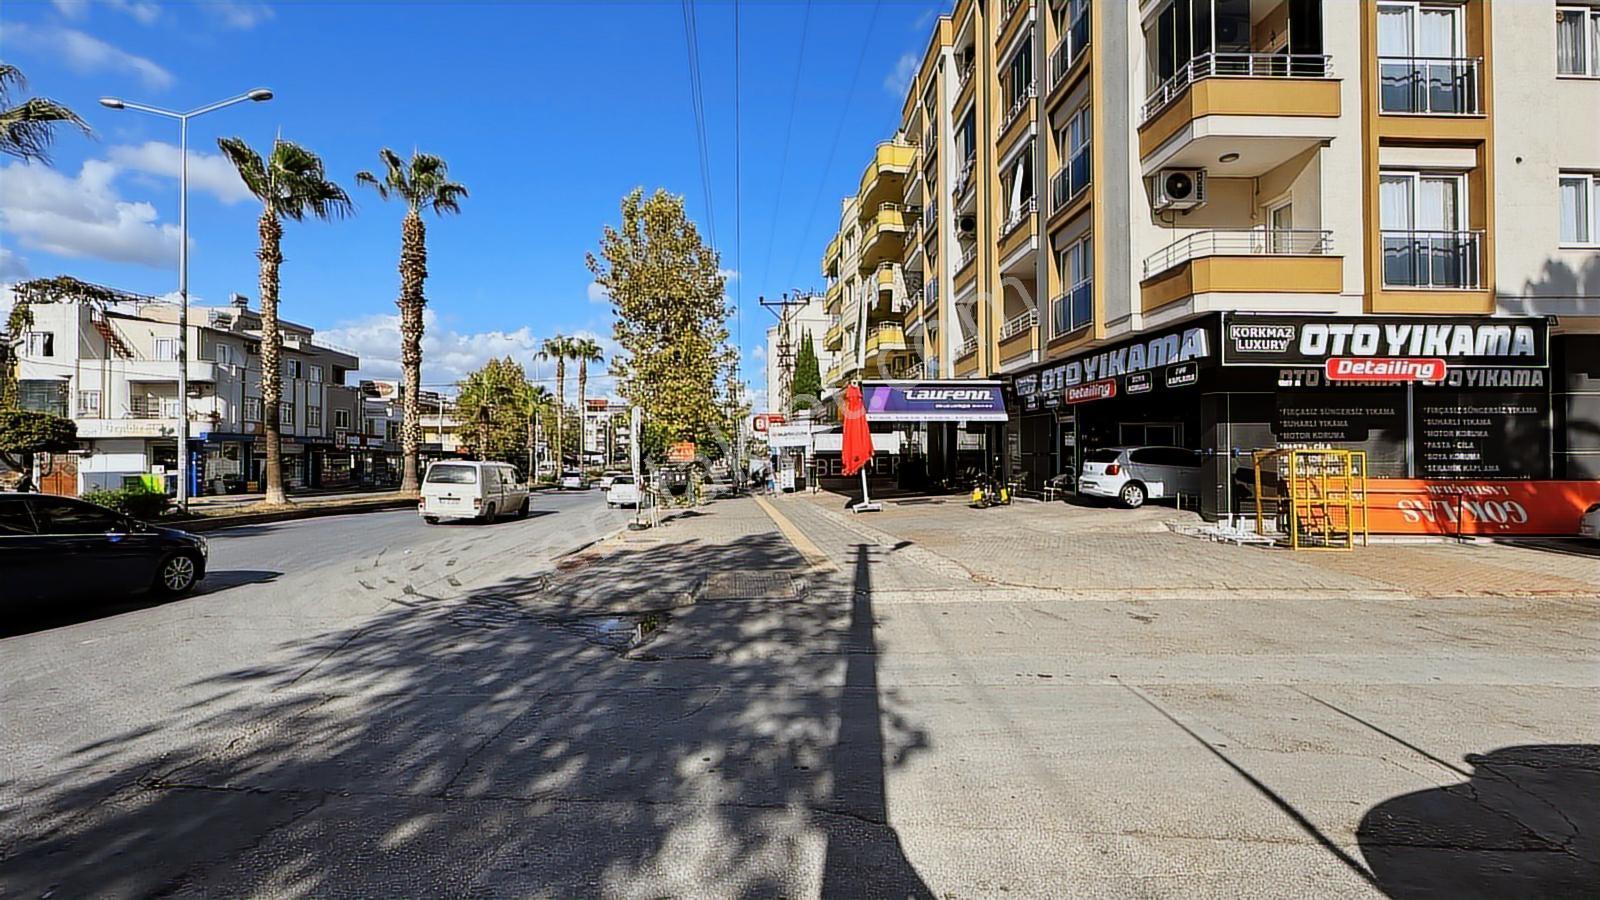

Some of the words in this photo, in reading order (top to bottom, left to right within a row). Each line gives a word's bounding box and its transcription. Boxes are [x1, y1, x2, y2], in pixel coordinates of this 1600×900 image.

[1232, 327, 1294, 338] KORKMAZ
[1300, 323, 1381, 356] OTO
[1384, 324, 1535, 356] YIKAMA
[1238, 339, 1288, 350] LUXURY
[1041, 361, 1082, 392] OTO
[1337, 360, 1435, 379] Detailing
[1466, 369, 1544, 387] YIKAMA
[903, 390, 994, 401] Laufenn
[1068, 382, 1111, 400] Detailing
